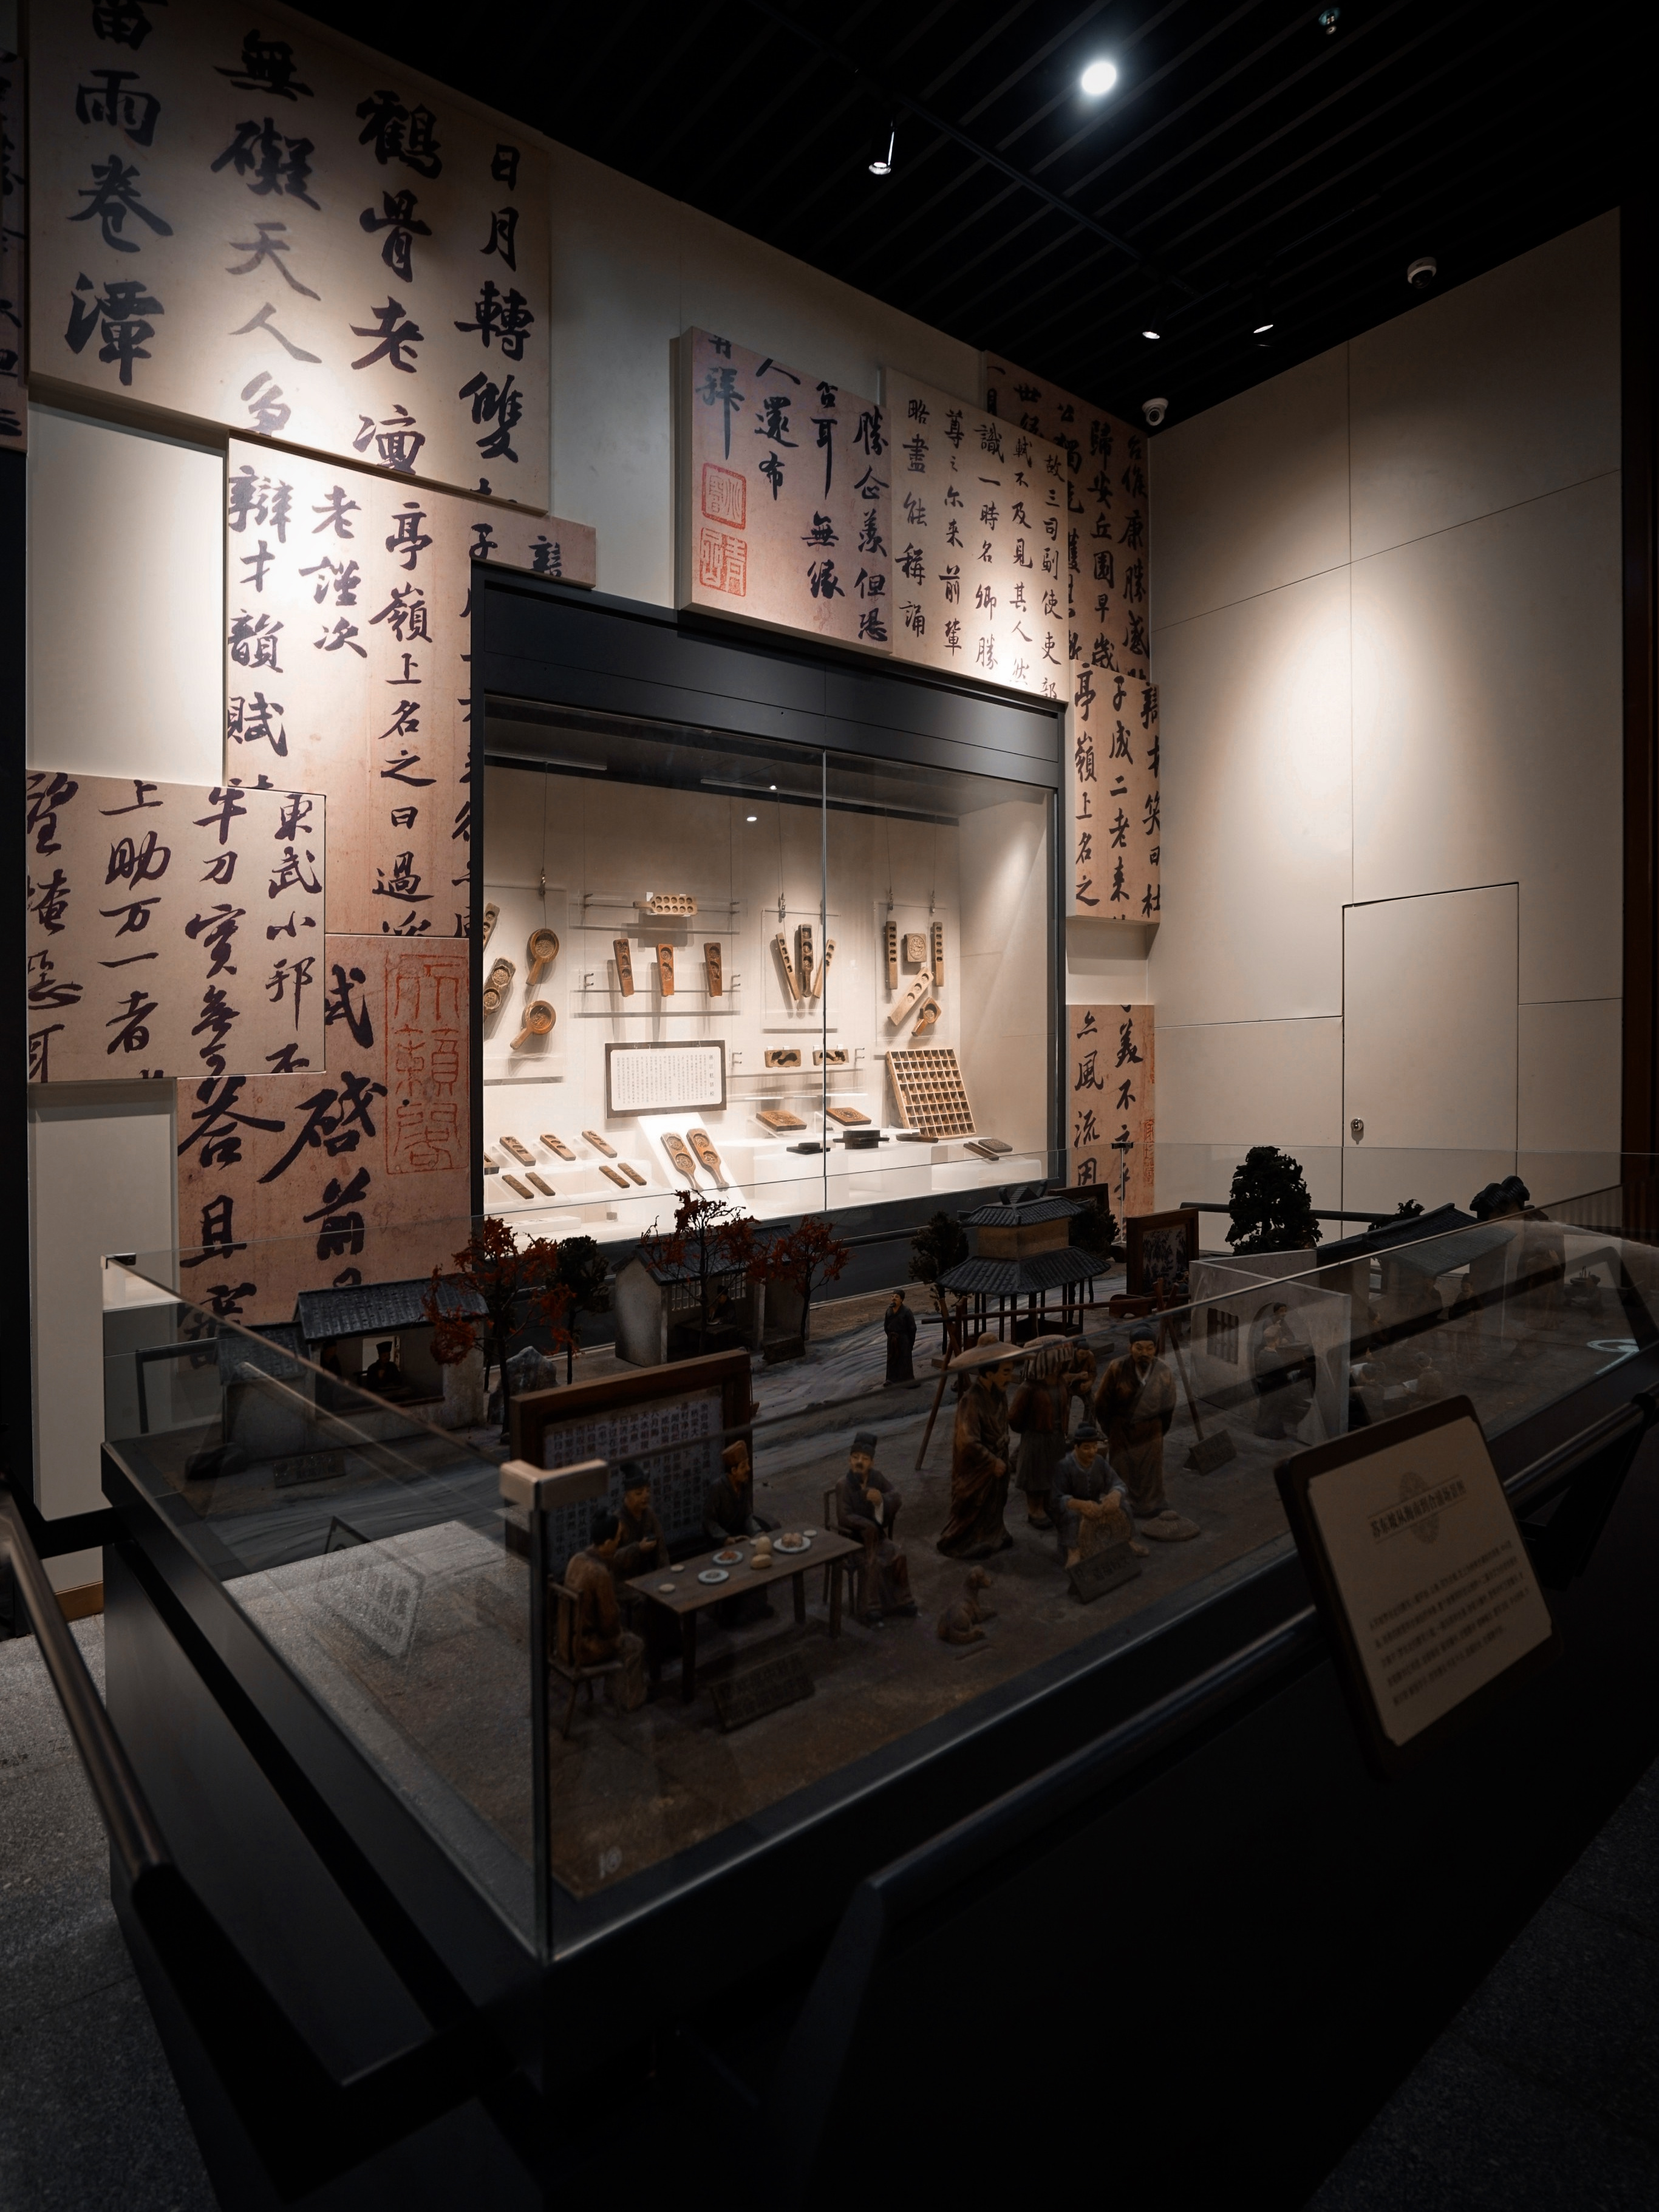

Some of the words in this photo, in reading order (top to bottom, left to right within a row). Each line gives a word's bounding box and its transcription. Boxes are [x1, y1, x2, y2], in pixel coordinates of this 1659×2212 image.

[454, 144, 534, 503] 日月轉雙
[228, 465, 294, 789] 辯才韻賦
[299, 486, 367, 658] 老謹次
[98, 780, 171, 1079] 上助万一者
[1075, 662, 1100, 907] 亭嶺上名之
